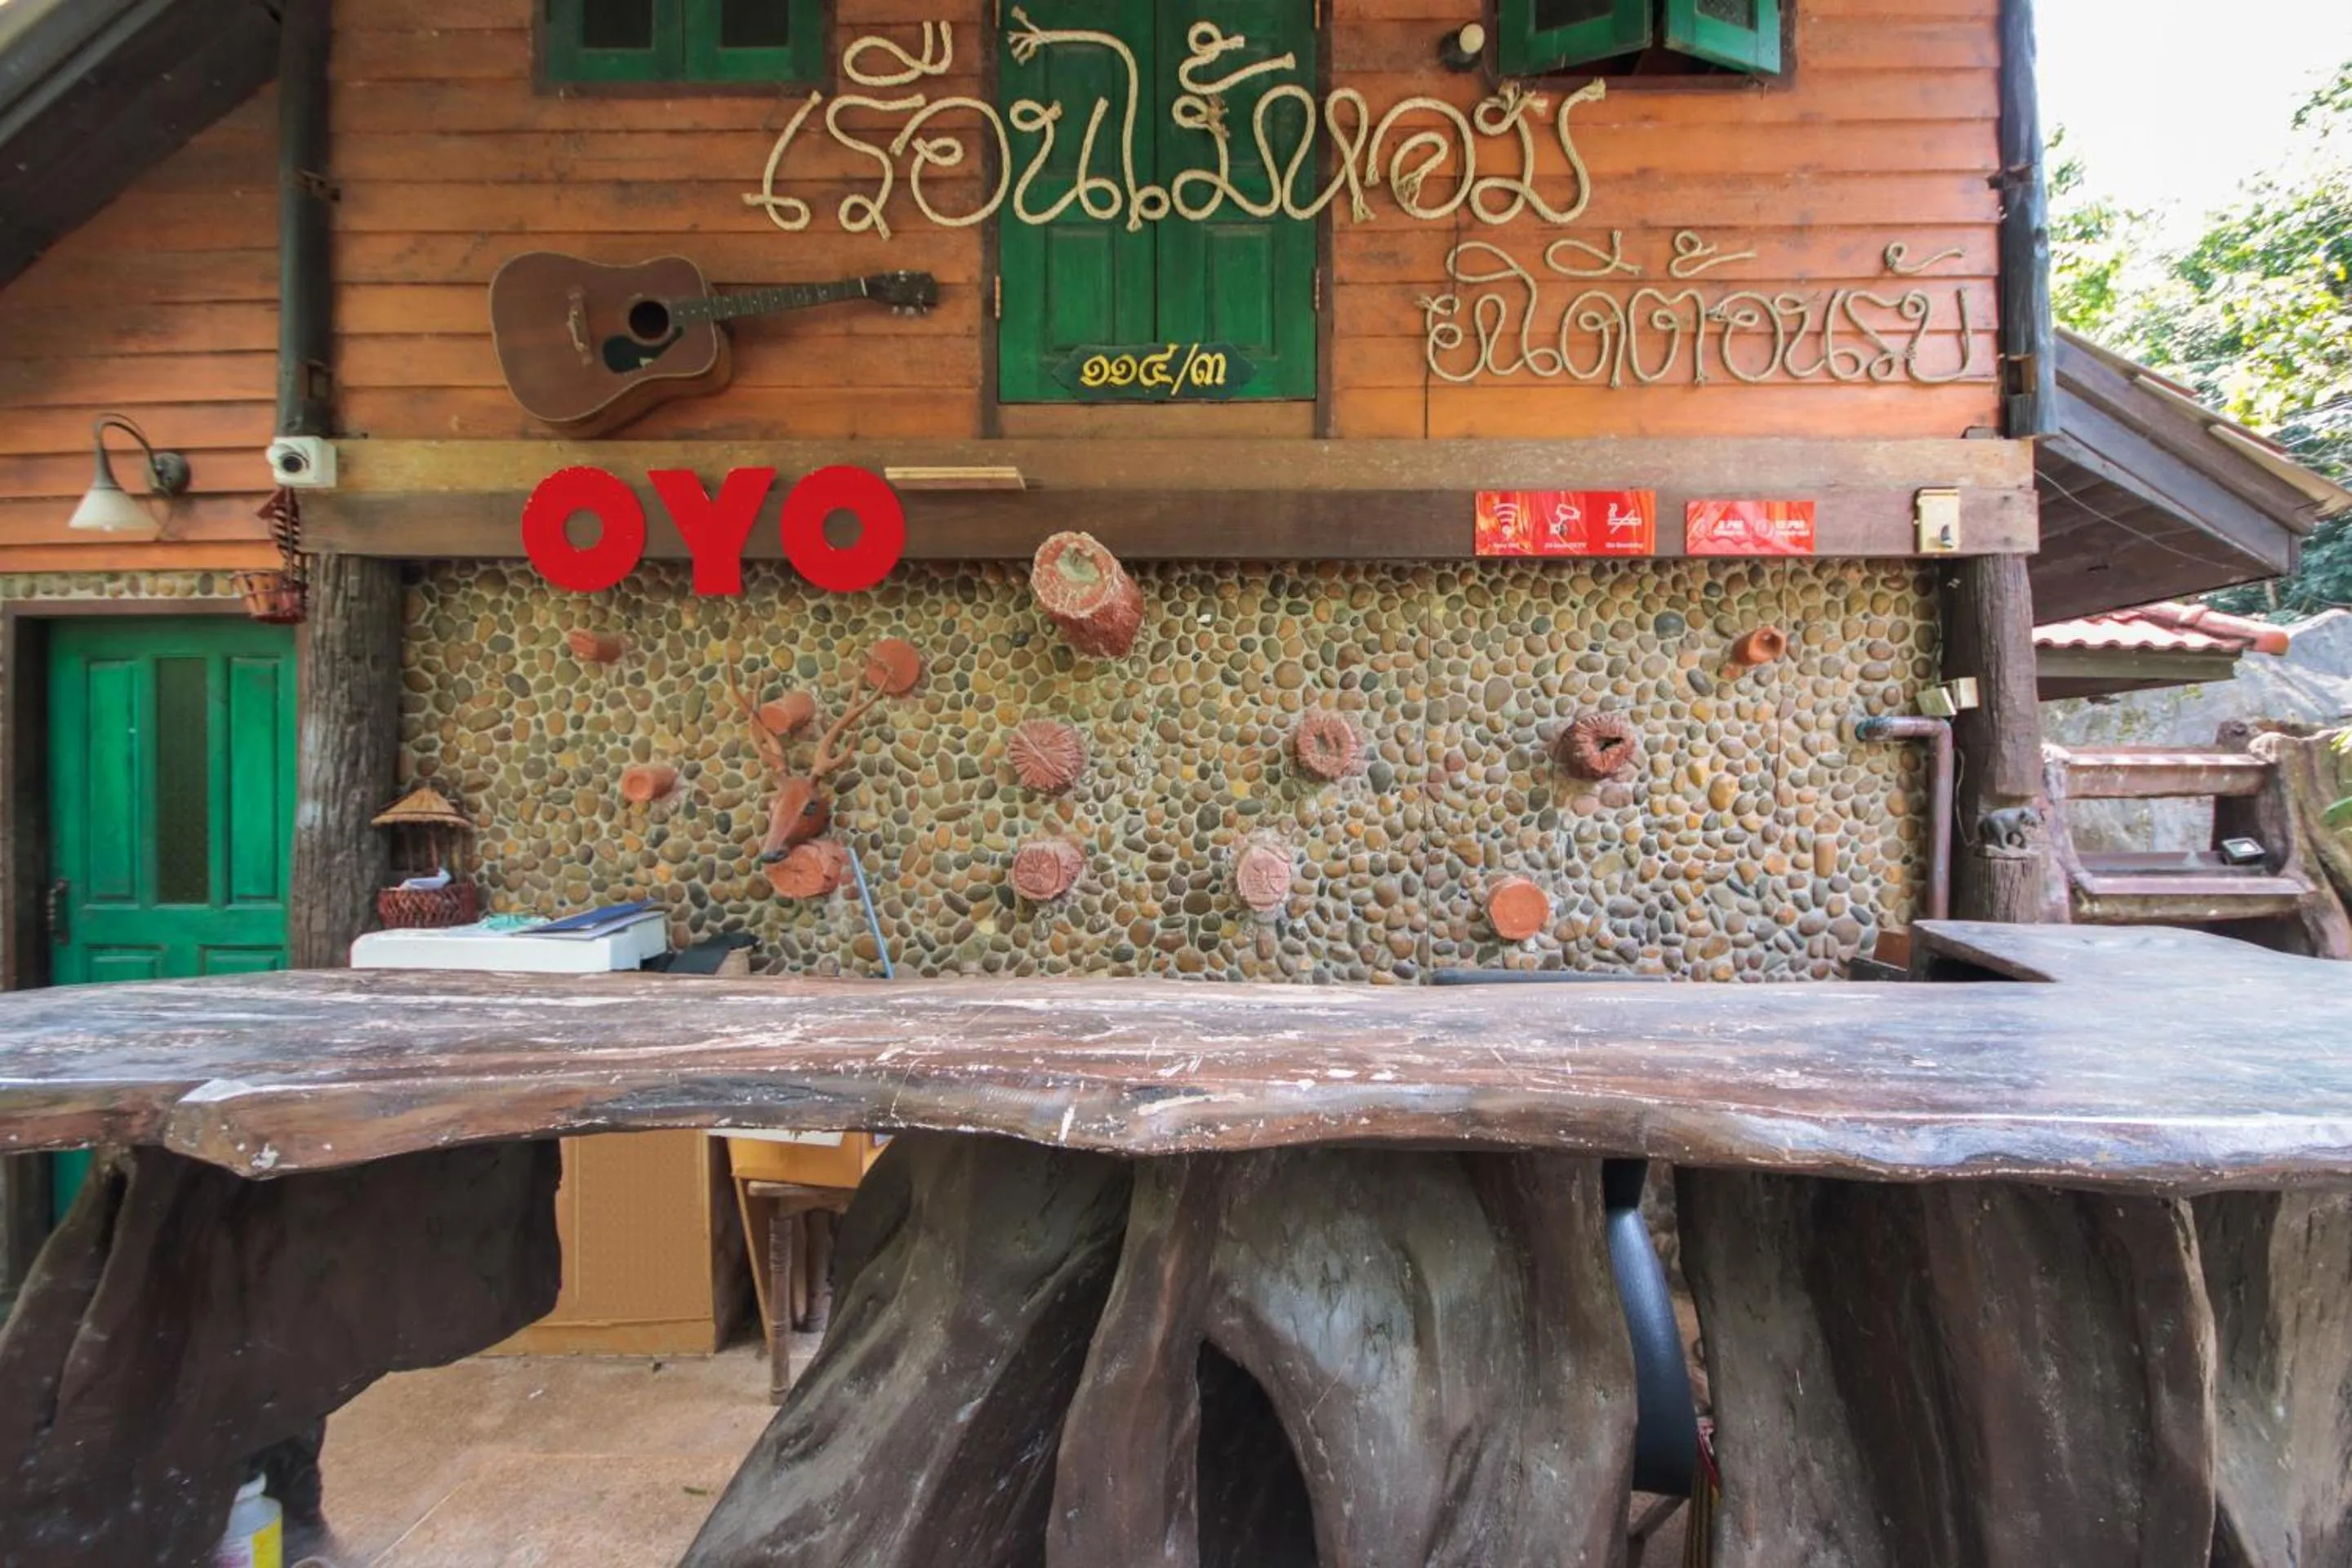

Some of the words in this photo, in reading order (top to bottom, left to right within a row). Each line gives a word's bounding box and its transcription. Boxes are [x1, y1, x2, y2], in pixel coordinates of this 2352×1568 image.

[1414, 229, 1972, 388] ยินดีต้อนรับ
[521, 464, 905, 596] OYO
